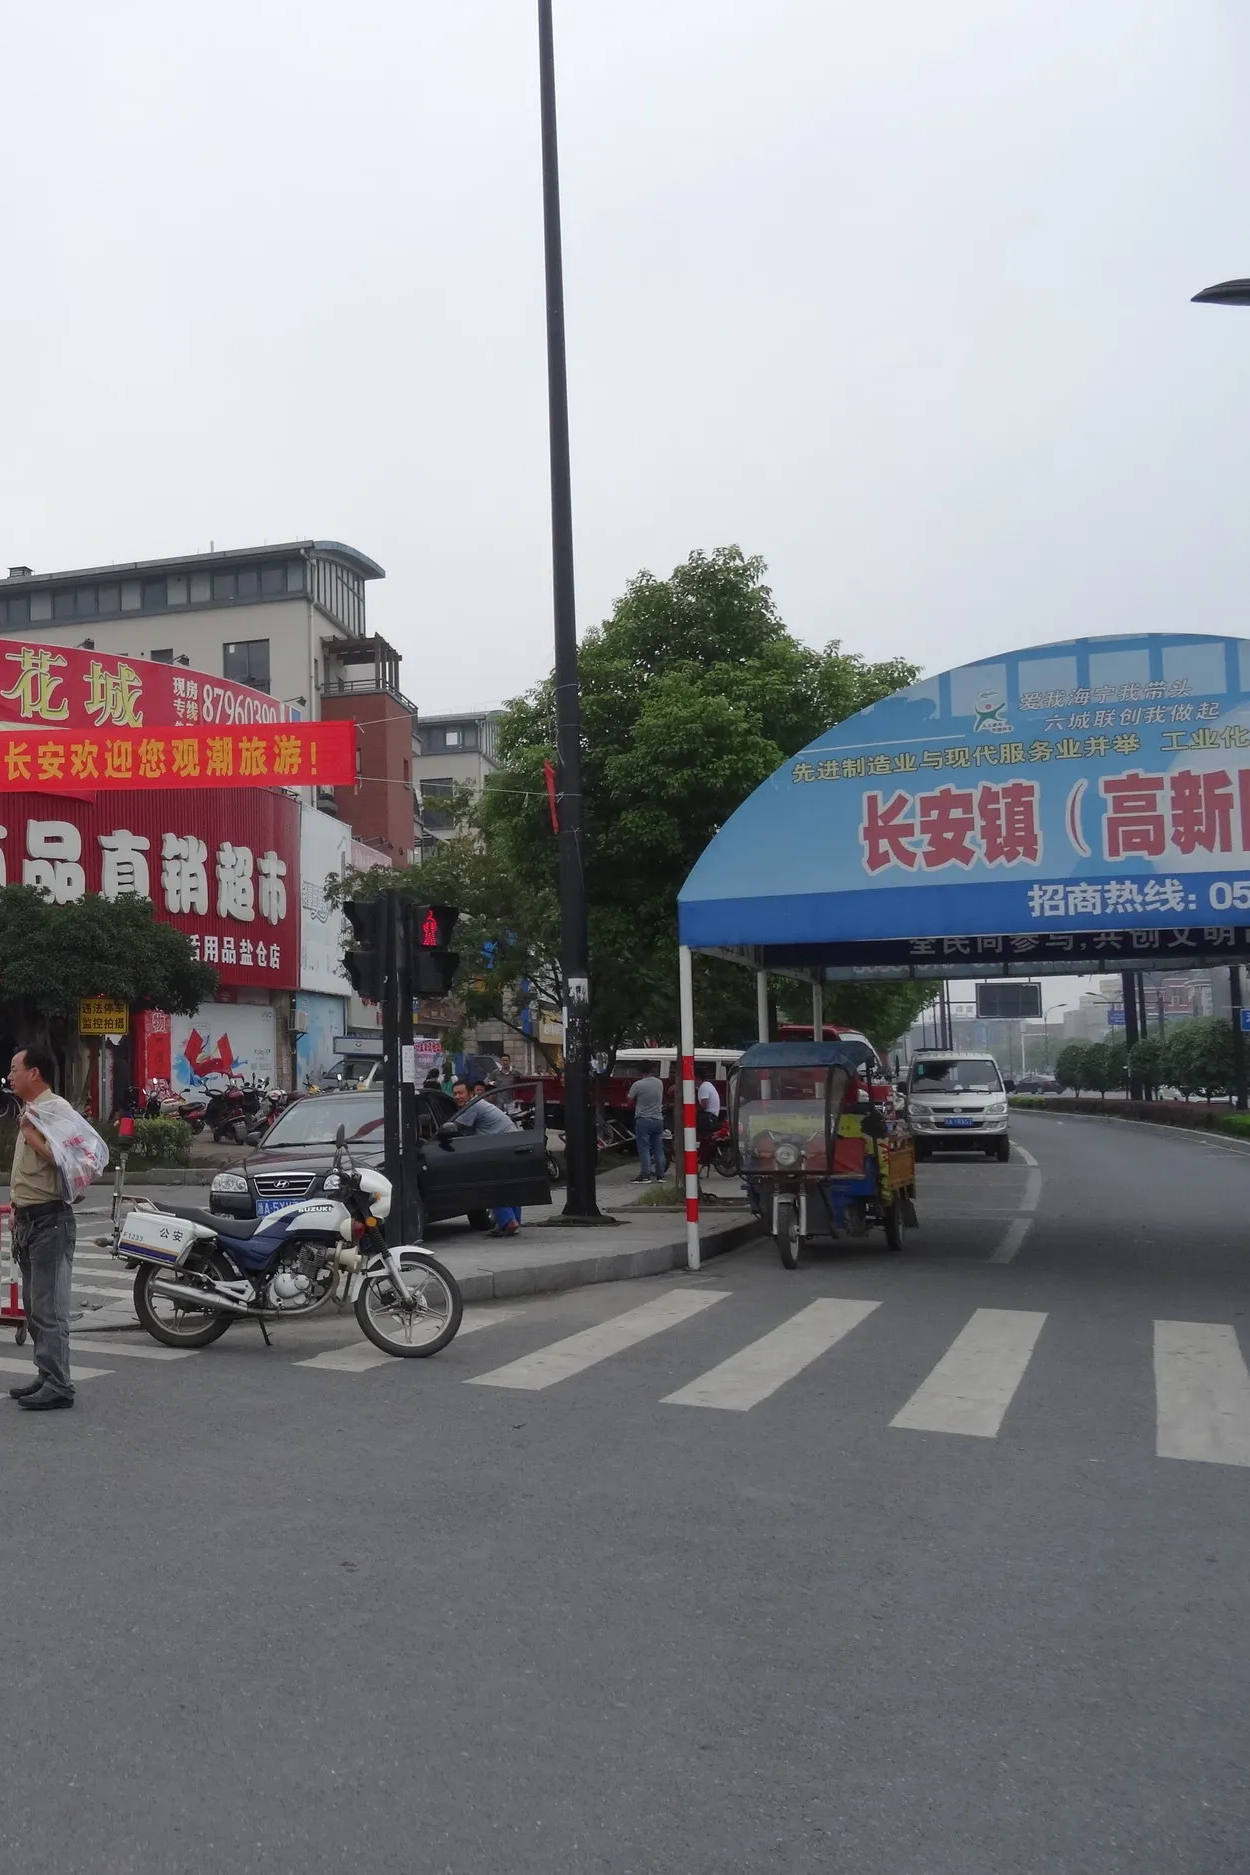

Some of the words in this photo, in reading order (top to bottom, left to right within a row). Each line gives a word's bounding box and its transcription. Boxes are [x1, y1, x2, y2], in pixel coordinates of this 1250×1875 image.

[1019, 679, 1193, 712] 爱我海宁我带头
[1043, 701, 1220, 733] 六城联创我做起
[791, 733, 1141, 784] 先进制造业与现代服务业并举
[159, 1227, 184, 1243] 公安
